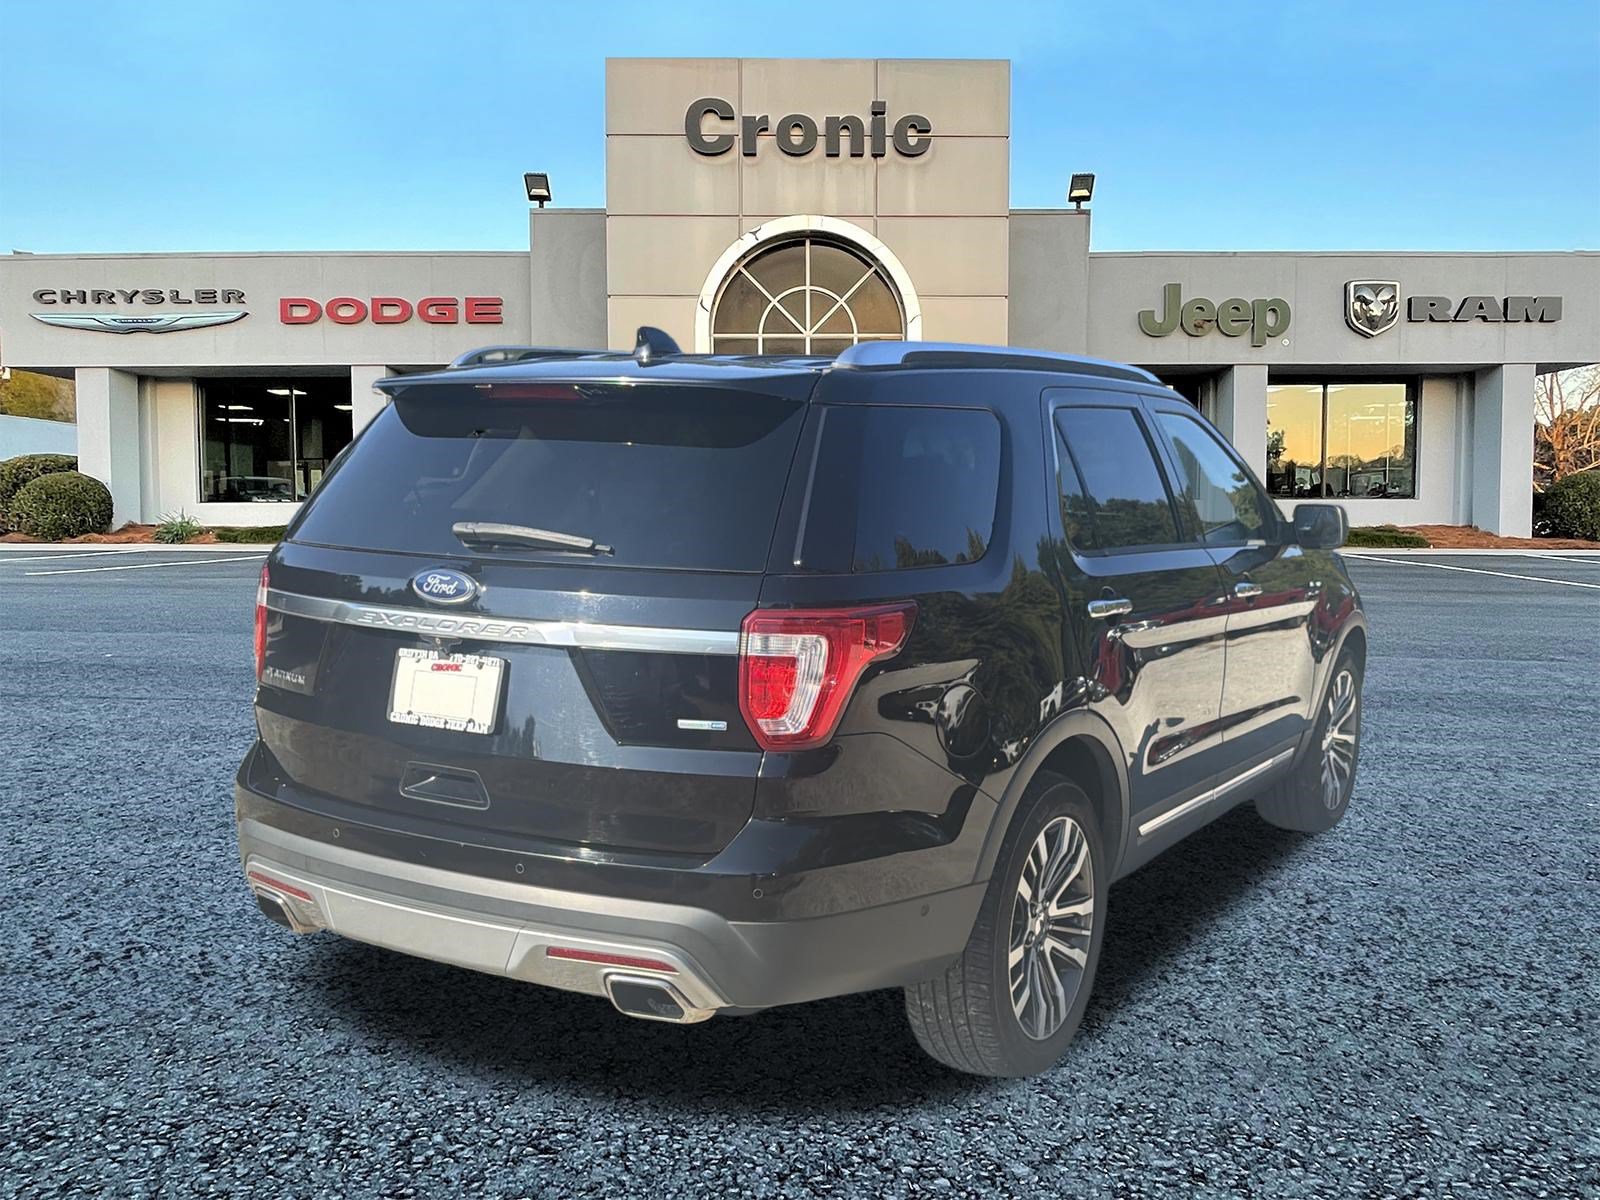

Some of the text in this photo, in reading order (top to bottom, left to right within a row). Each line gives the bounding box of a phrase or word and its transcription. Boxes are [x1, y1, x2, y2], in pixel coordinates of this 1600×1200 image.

[684, 97, 932, 157] Cronic
[32, 289, 246, 304] CHRYSLER
[1407, 296, 1563, 323] RAM
[280, 297, 503, 325] DODGE
[1138, 283, 1292, 348] Jeep
[423, 574, 458, 595] Ford
[357, 612, 529, 639] EXPLORER
